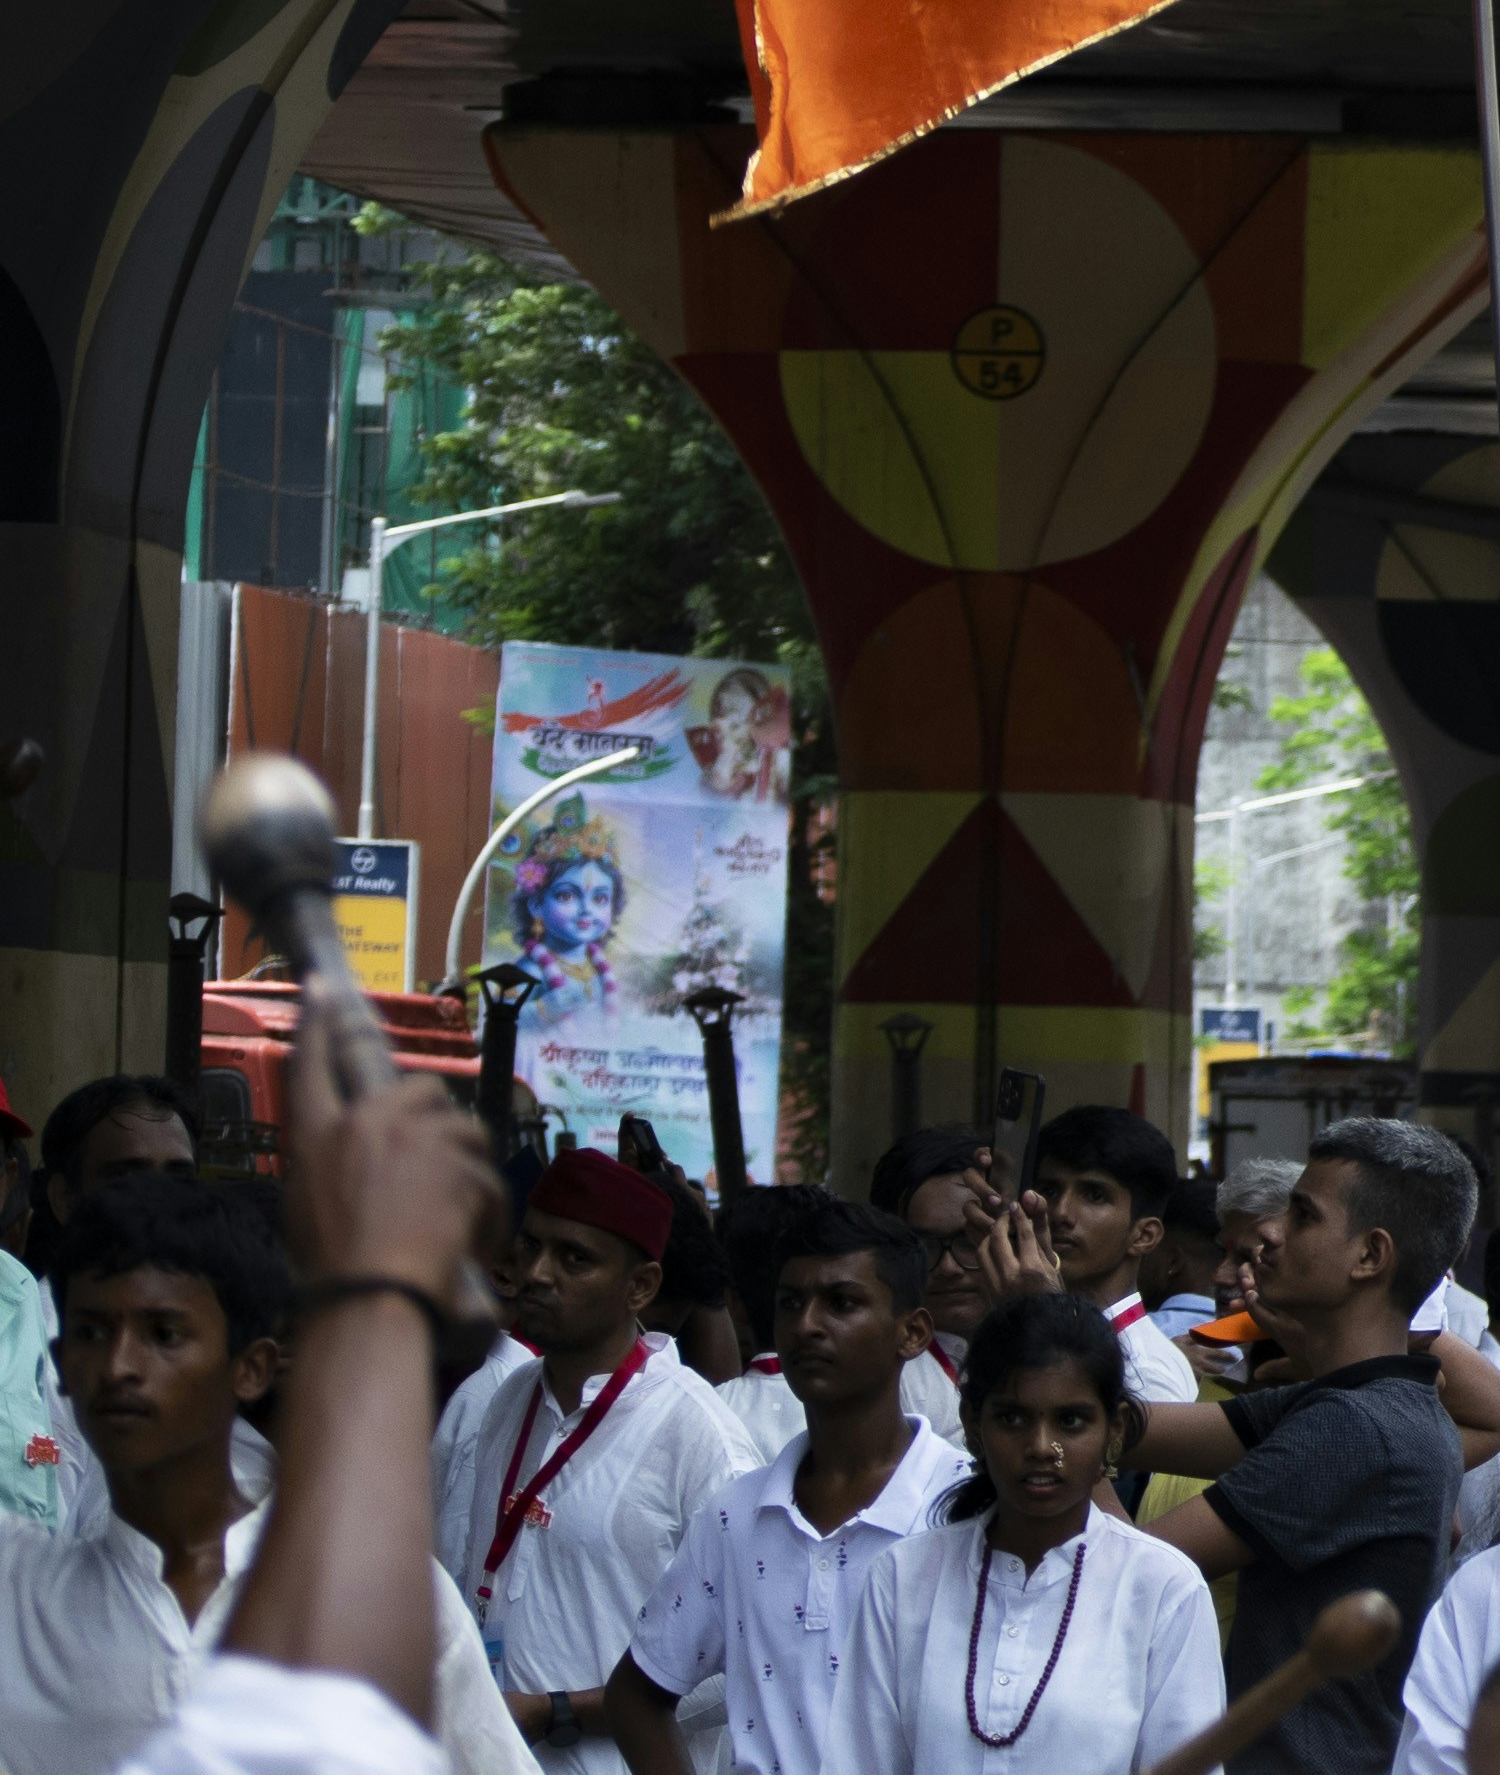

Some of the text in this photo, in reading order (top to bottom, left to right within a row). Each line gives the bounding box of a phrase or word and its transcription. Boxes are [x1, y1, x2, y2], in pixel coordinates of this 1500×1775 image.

[991, 317, 1014, 344] P
[980, 360, 1023, 391] 54
[354, 876, 397, 894] Realty
[344, 942, 400, 953] ATEWAY
